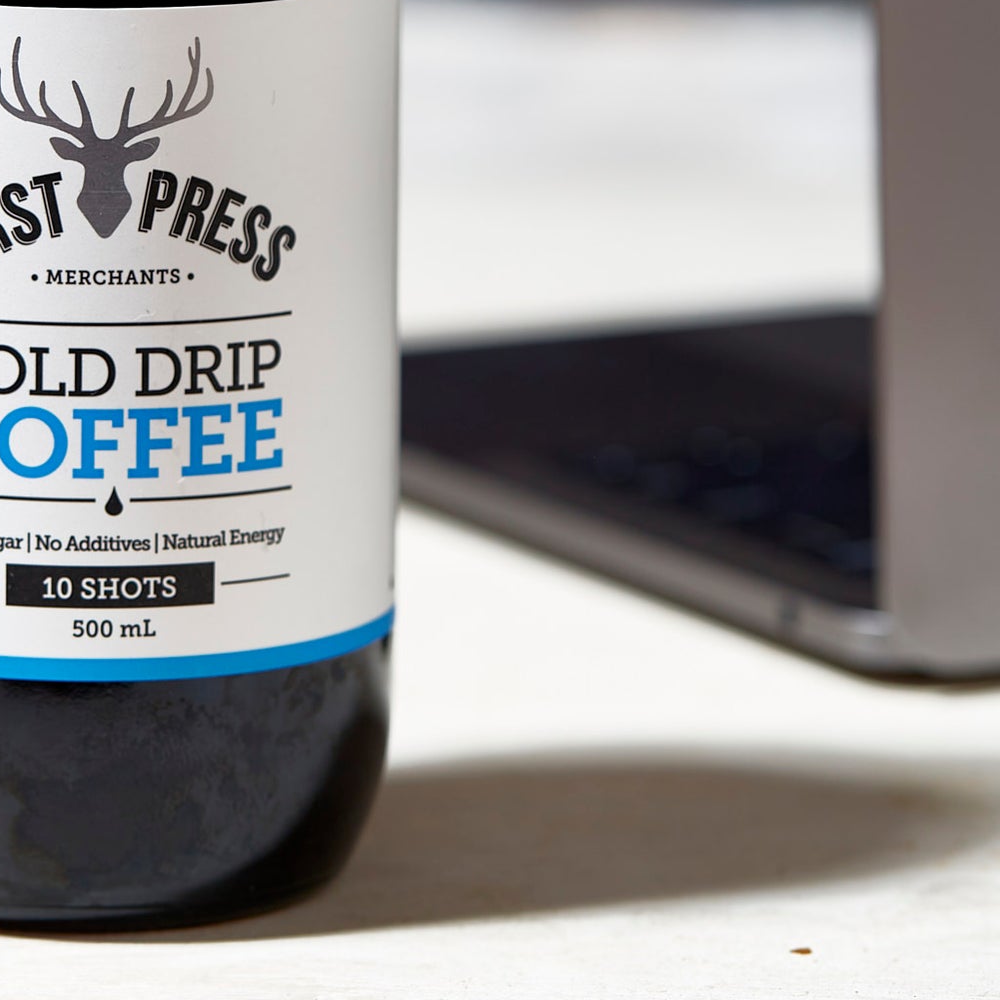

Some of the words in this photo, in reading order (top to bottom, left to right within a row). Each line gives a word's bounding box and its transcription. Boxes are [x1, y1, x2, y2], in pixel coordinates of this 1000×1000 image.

[137, 169, 297, 283] PRESS
[45, 268, 181, 286] MERCHANTS
[135, 339, 282, 398] DRIP
[35, 534, 63, 552] No
[65, 535, 151, 553] Additives
[162, 530, 227, 551] Natural
[229, 526, 286, 548] Energy
[43, 577, 72, 599] 10
[81, 576, 177, 600] SHOTS
[72, 619, 114, 639] 500
[119, 619, 157, 638] mL
